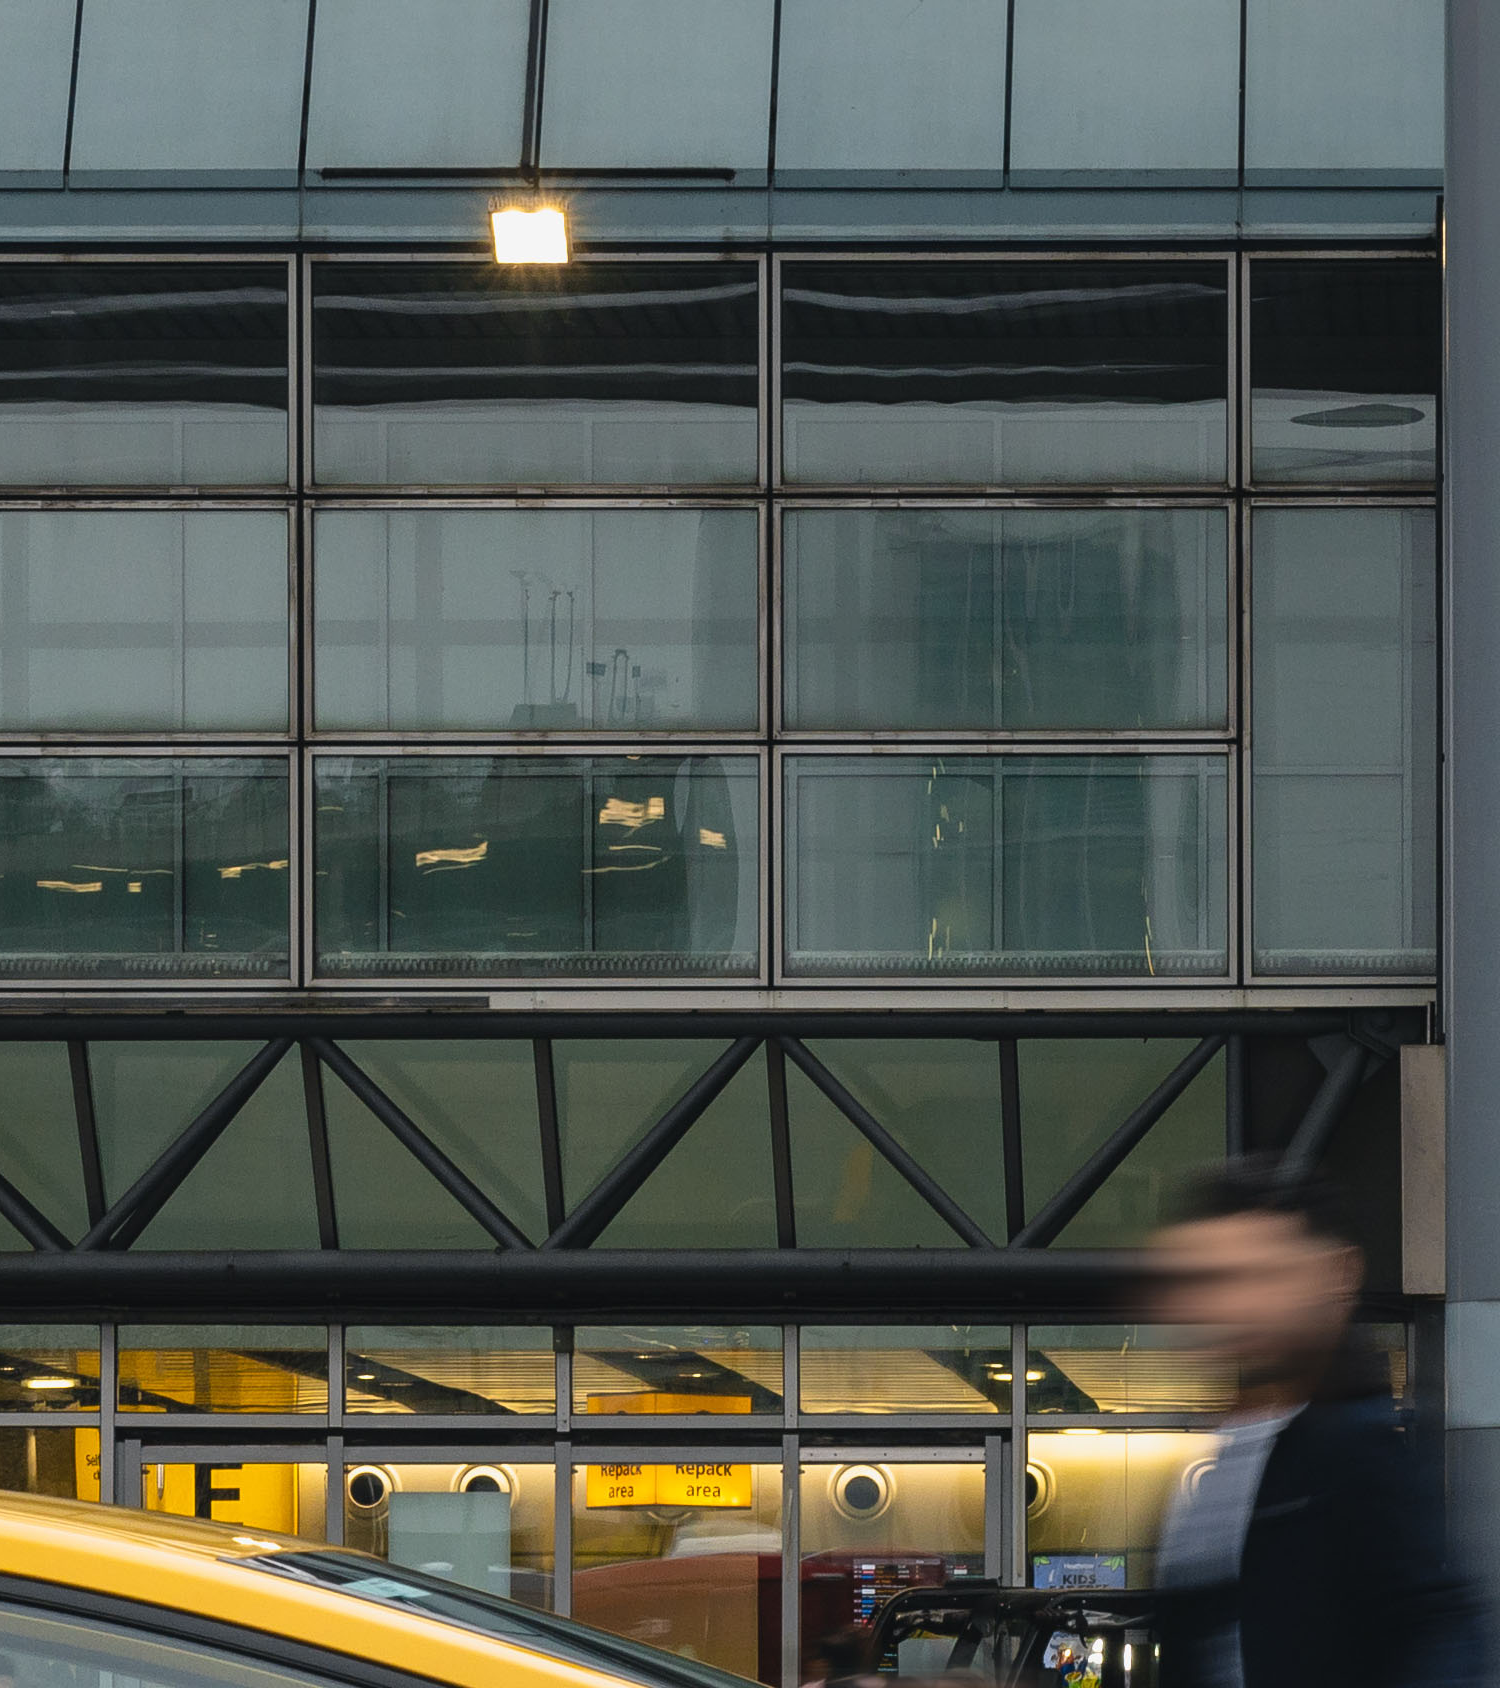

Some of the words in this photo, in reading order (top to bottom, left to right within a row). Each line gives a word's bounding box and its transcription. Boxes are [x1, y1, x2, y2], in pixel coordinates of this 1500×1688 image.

[608, 1486, 634, 1498] area
[686, 1484, 721, 1498] area
[1062, 1574, 1097, 1585] KIDS
